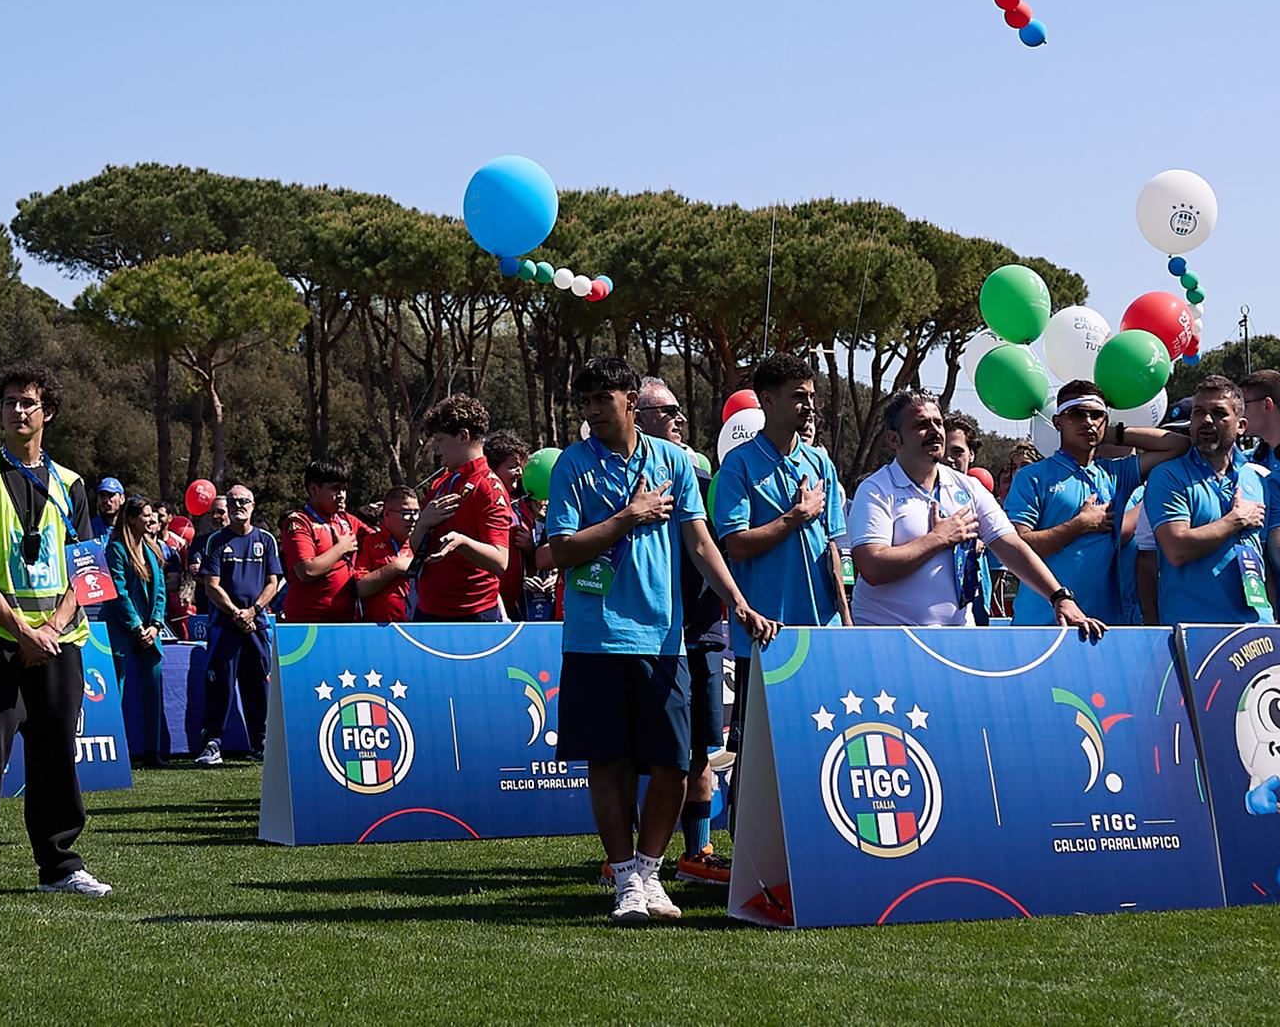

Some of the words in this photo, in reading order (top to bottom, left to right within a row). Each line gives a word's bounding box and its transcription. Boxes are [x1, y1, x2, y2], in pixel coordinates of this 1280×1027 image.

[1085, 341, 1102, 353] TUT
[731, 431, 757, 440] CALC
[342, 727, 390, 750] FIGC
[531, 761, 568, 775] FIGC
[500, 779, 535, 790] CALCIO
[537, 777, 589, 789] PARALIMPI
[850, 768, 911, 799] FIGC
[872, 800, 896, 810] ITALIA
[1091, 814, 1137, 831] FIGC
[1054, 838, 1097, 853] CALCIO
[1099, 835, 1180, 851] PARALIMPICO
